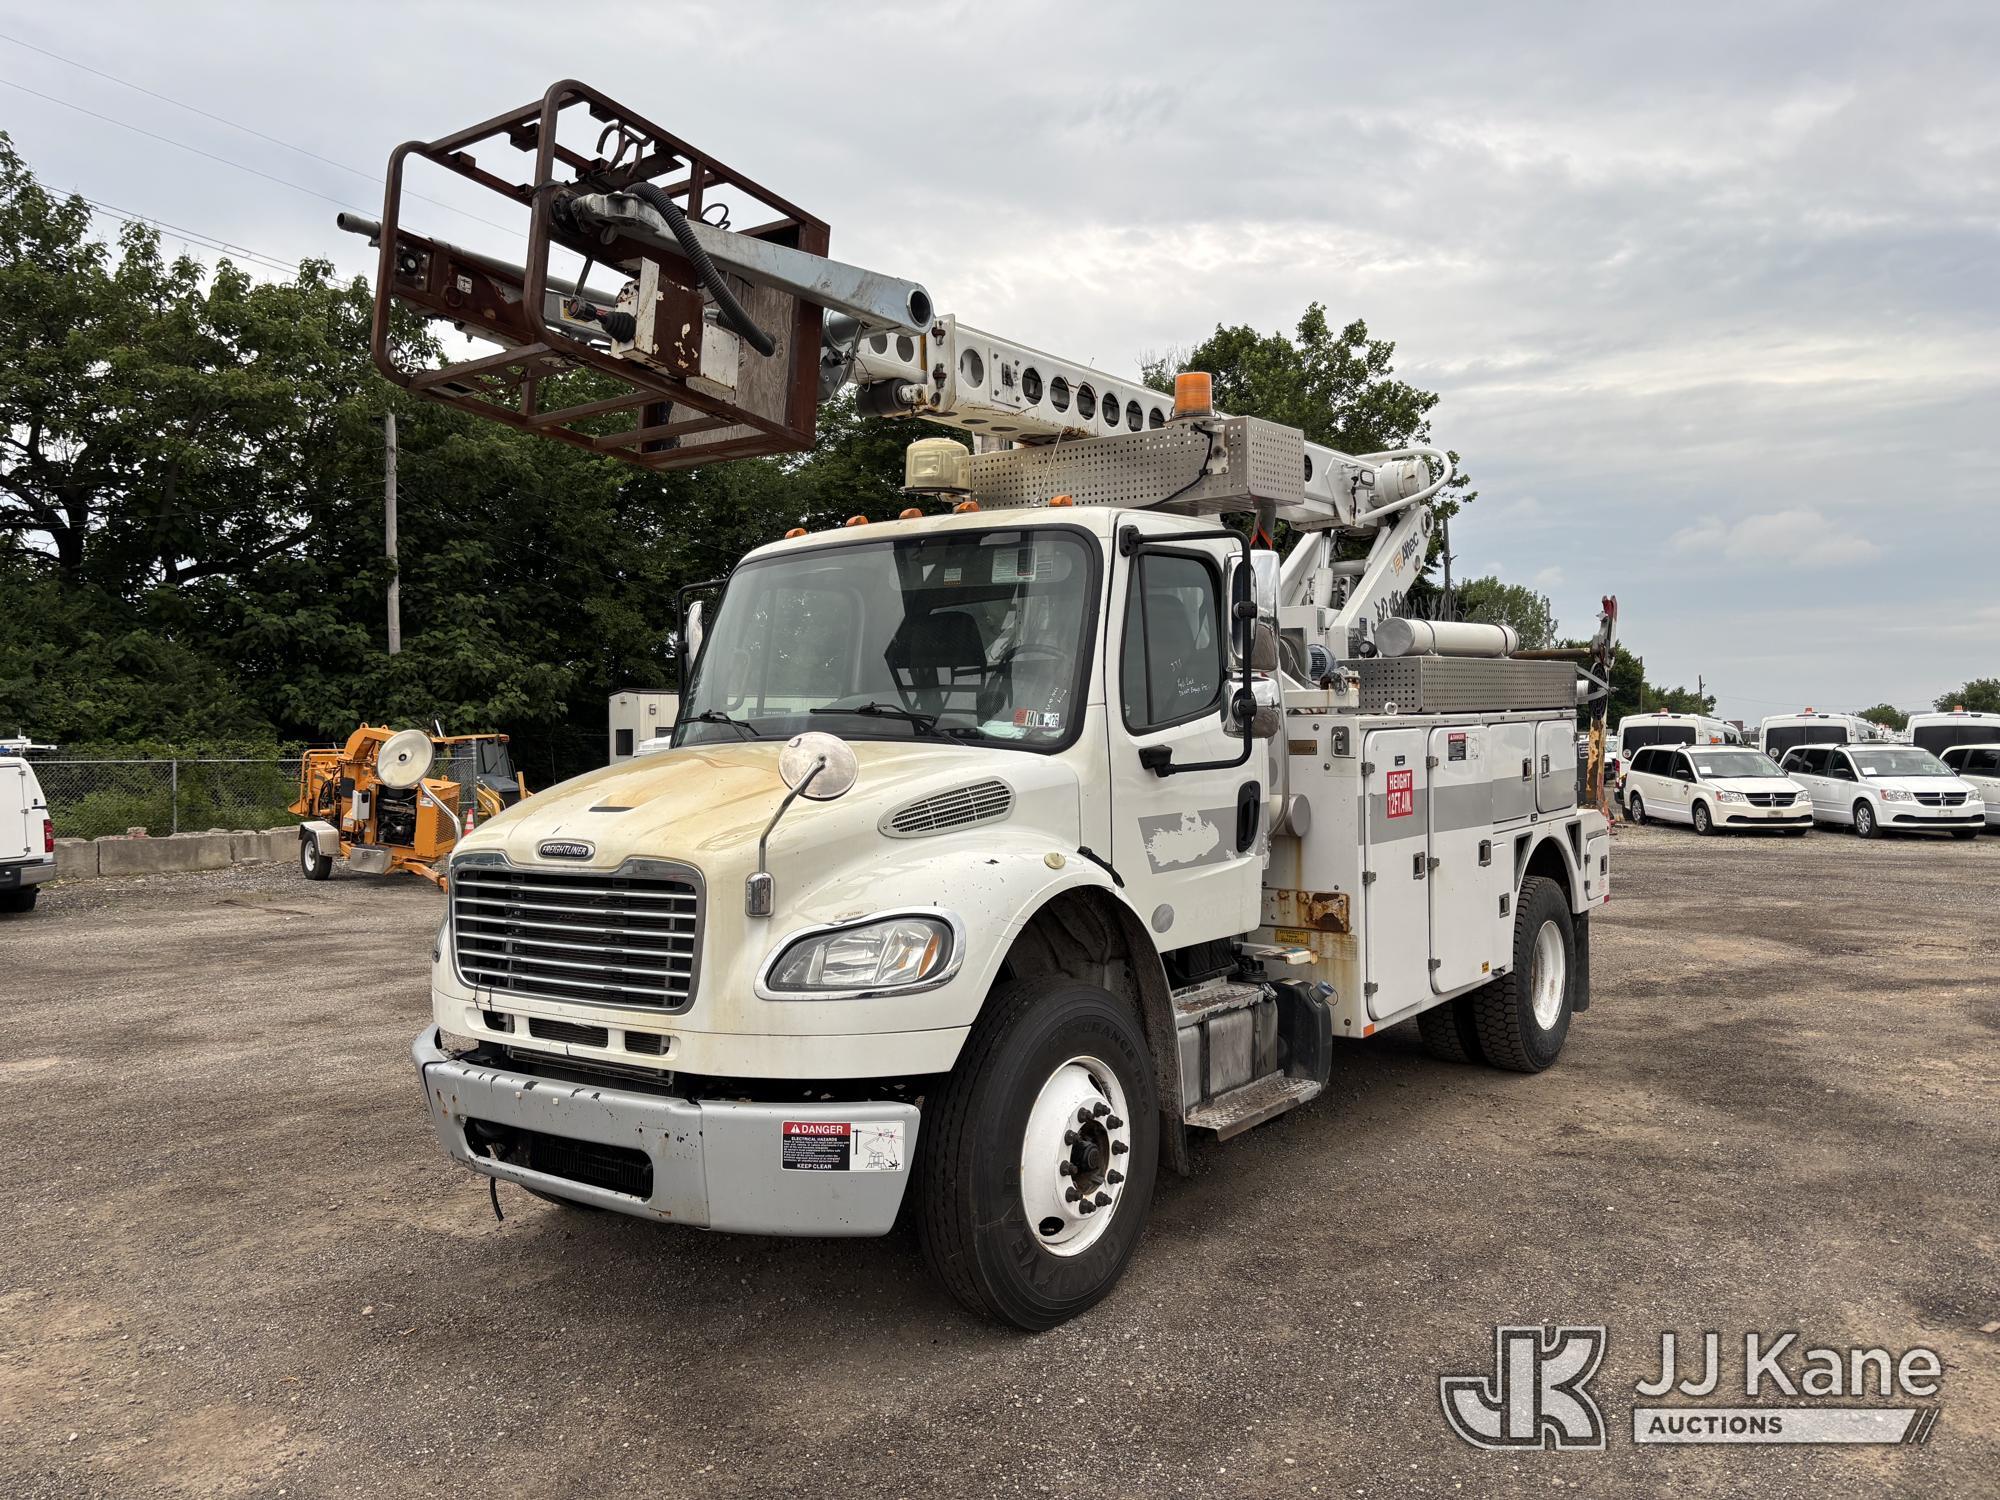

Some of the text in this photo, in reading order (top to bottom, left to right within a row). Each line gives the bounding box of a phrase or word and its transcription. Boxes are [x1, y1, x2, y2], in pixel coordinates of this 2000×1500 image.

[1389, 772, 1411, 790] HEIGHT
[541, 845, 587, 855] FREIGHTLINER
[801, 1125, 844, 1134] DANGER
